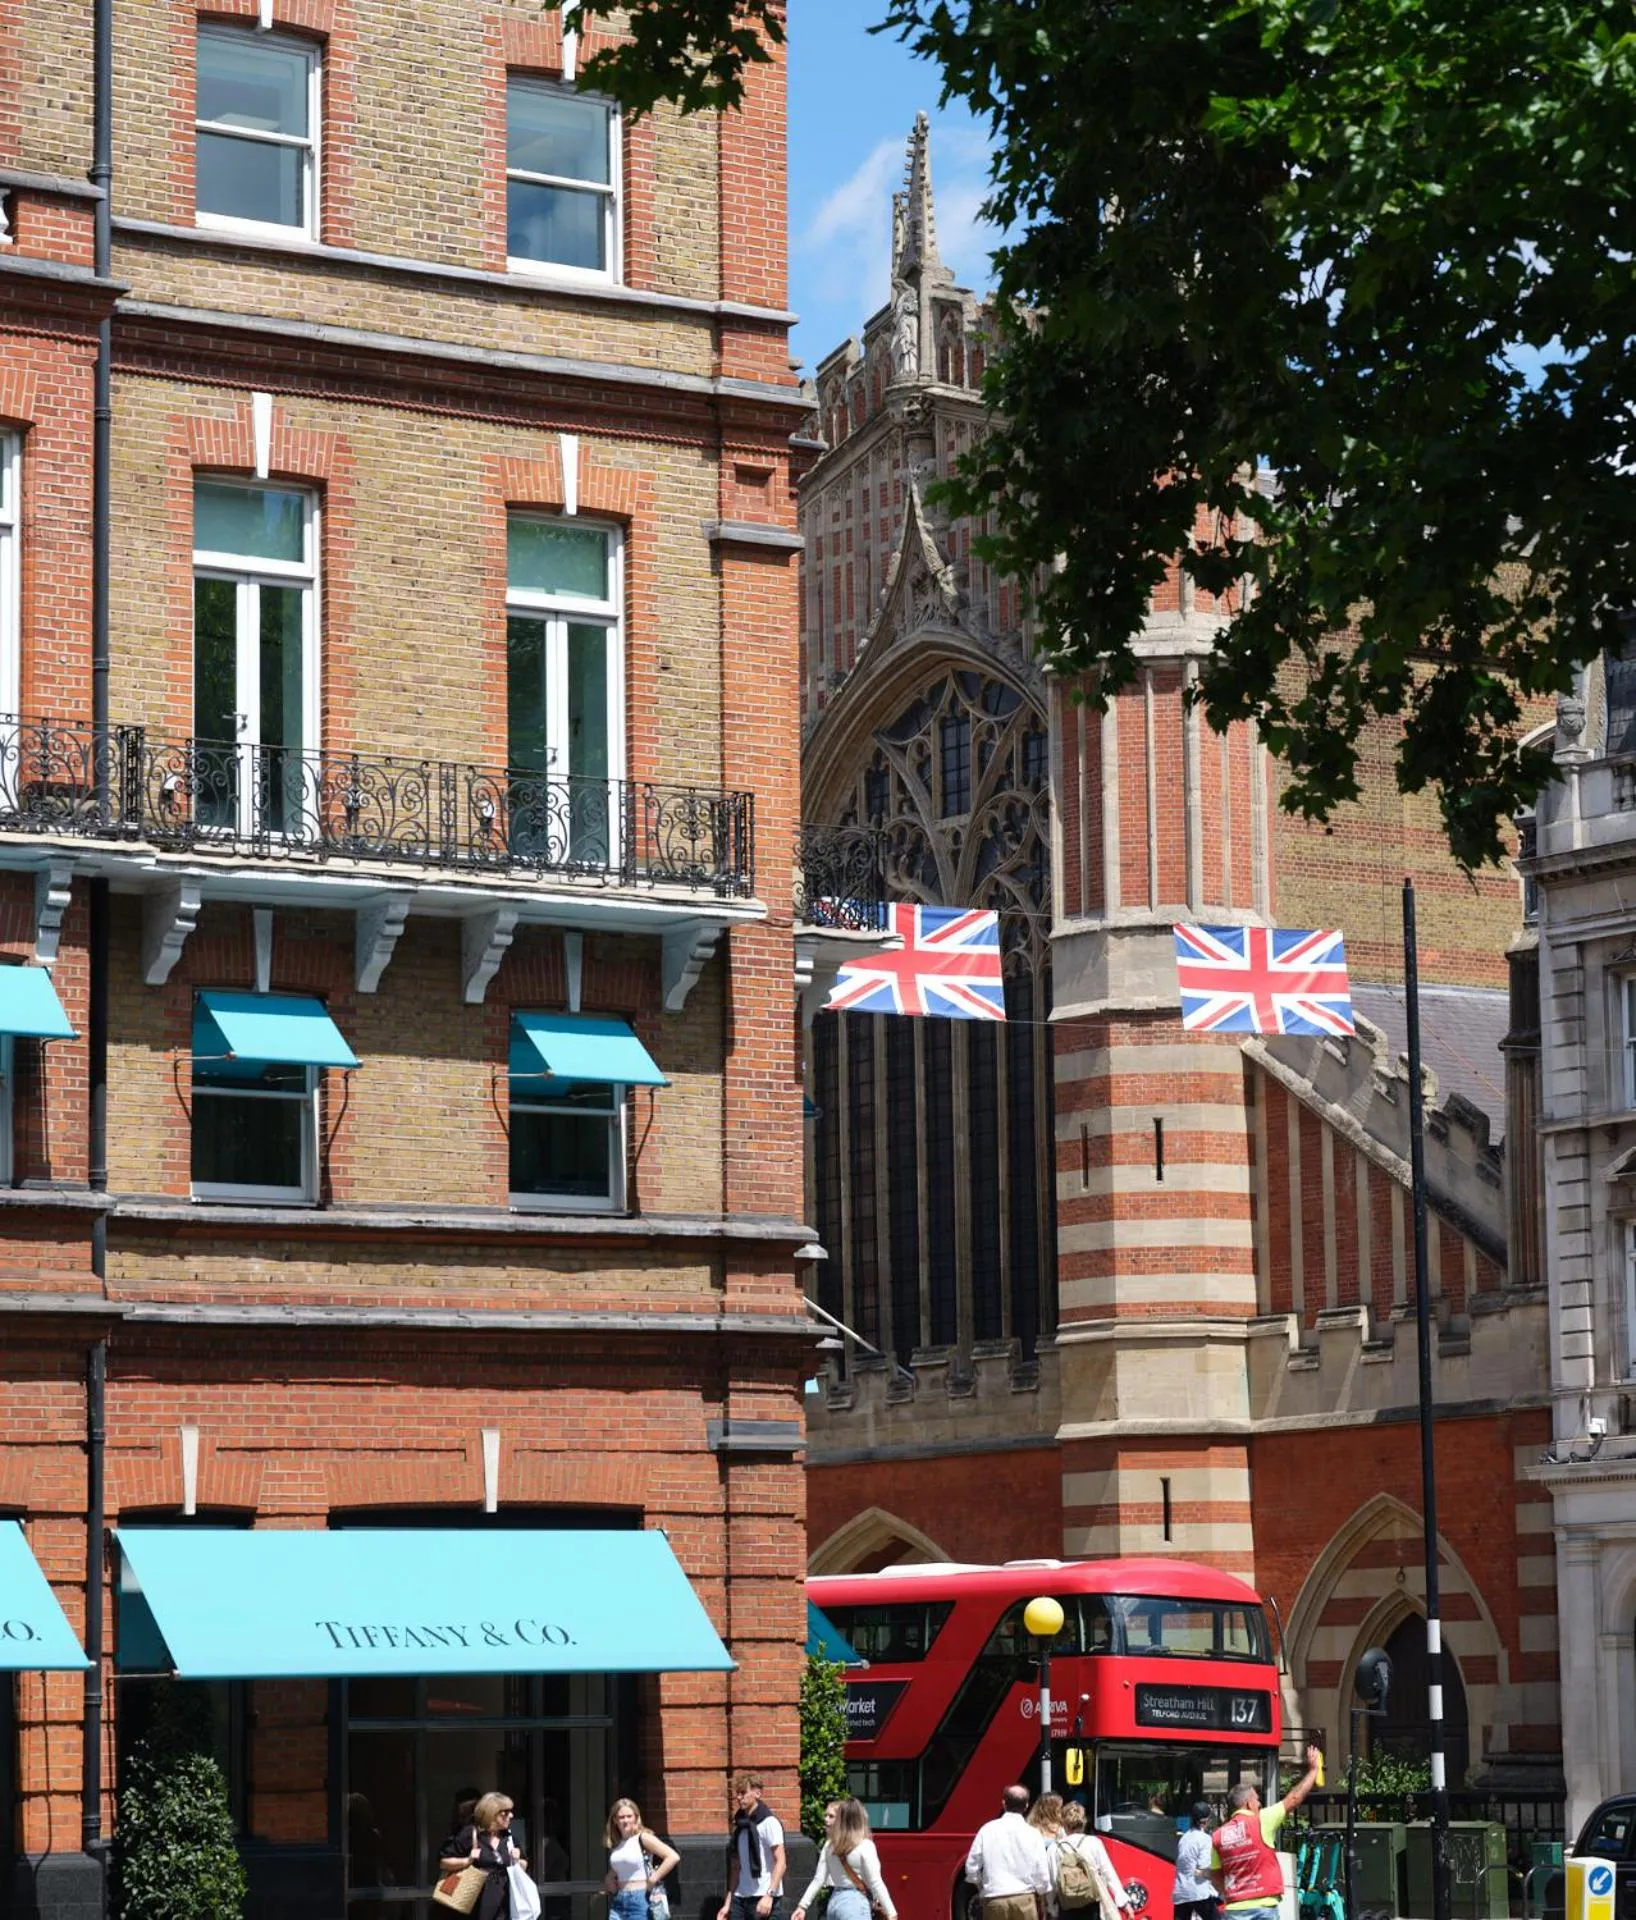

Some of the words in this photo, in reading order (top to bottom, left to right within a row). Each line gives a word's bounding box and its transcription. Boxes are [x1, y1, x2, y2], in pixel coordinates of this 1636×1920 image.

[0, 1619, 42, 1641] O.
[315, 1621, 471, 1649] TIFFANY
[480, 1621, 512, 1647] &
[1143, 1692, 1195, 1710] Streatham
[1197, 1695, 1216, 1711] Hill
[1231, 1697, 1259, 1723] 137
[1151, 1709, 1180, 1718] TELFORD
